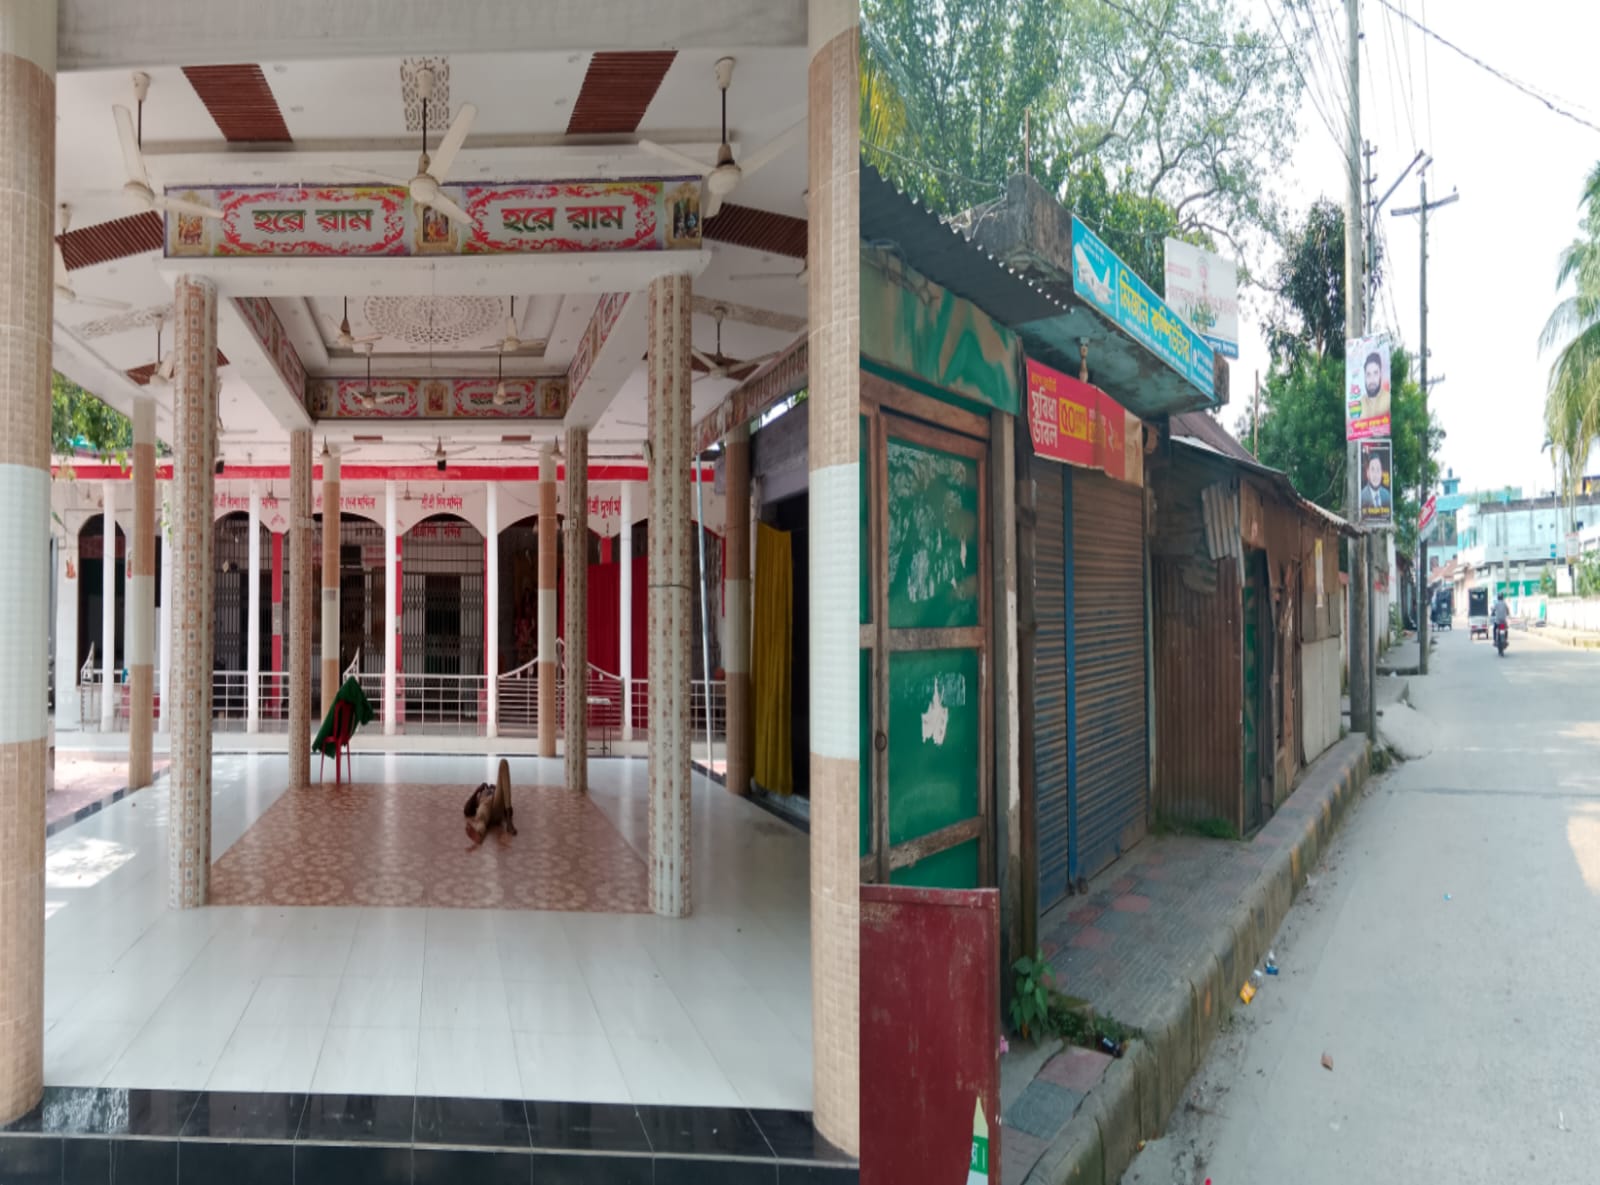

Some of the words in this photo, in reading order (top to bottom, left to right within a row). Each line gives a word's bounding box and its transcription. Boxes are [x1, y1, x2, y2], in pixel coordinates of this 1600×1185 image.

[252, 208, 305, 233] হরে
[315, 208, 374, 233] রাম
[500, 206, 557, 233] হরে
[565, 205, 626, 232] রাম
[1031, 386, 1057, 421] সুবিধা
[1032, 417, 1058, 449] ডাবল
